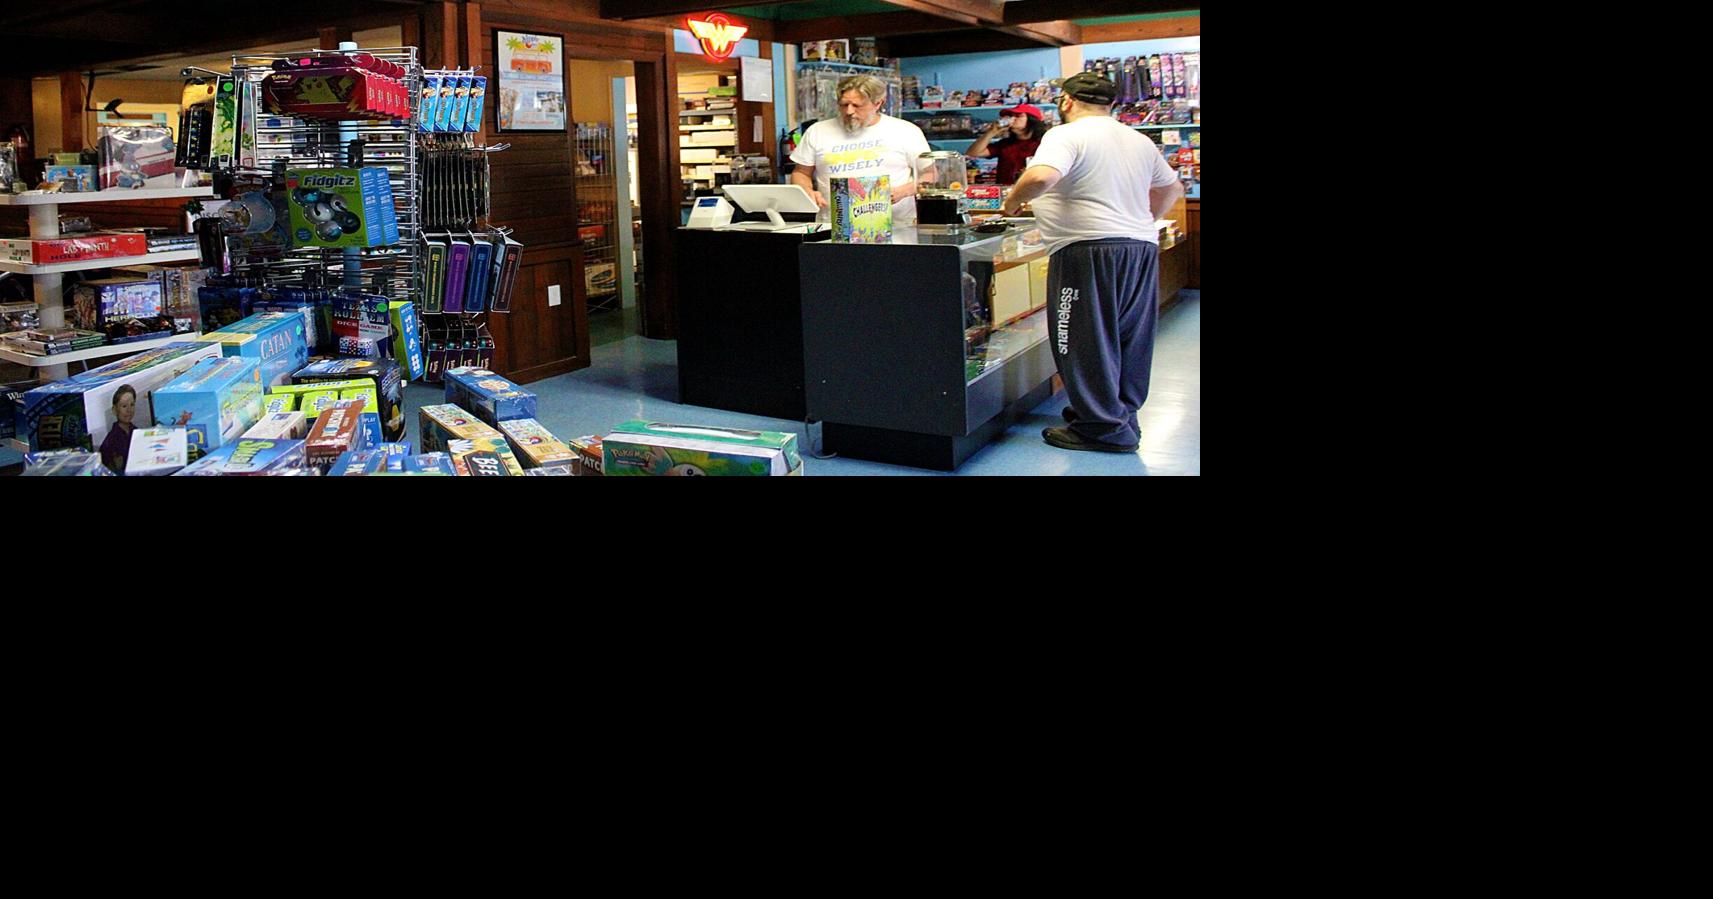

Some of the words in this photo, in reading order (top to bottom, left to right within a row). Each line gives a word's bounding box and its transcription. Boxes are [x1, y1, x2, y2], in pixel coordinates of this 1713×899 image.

[831, 139, 884, 153] CHOOSE
[830, 158, 884, 174] WISELY
[303, 173, 356, 188] Fidgitz
[261, 330, 291, 360] CATAN
